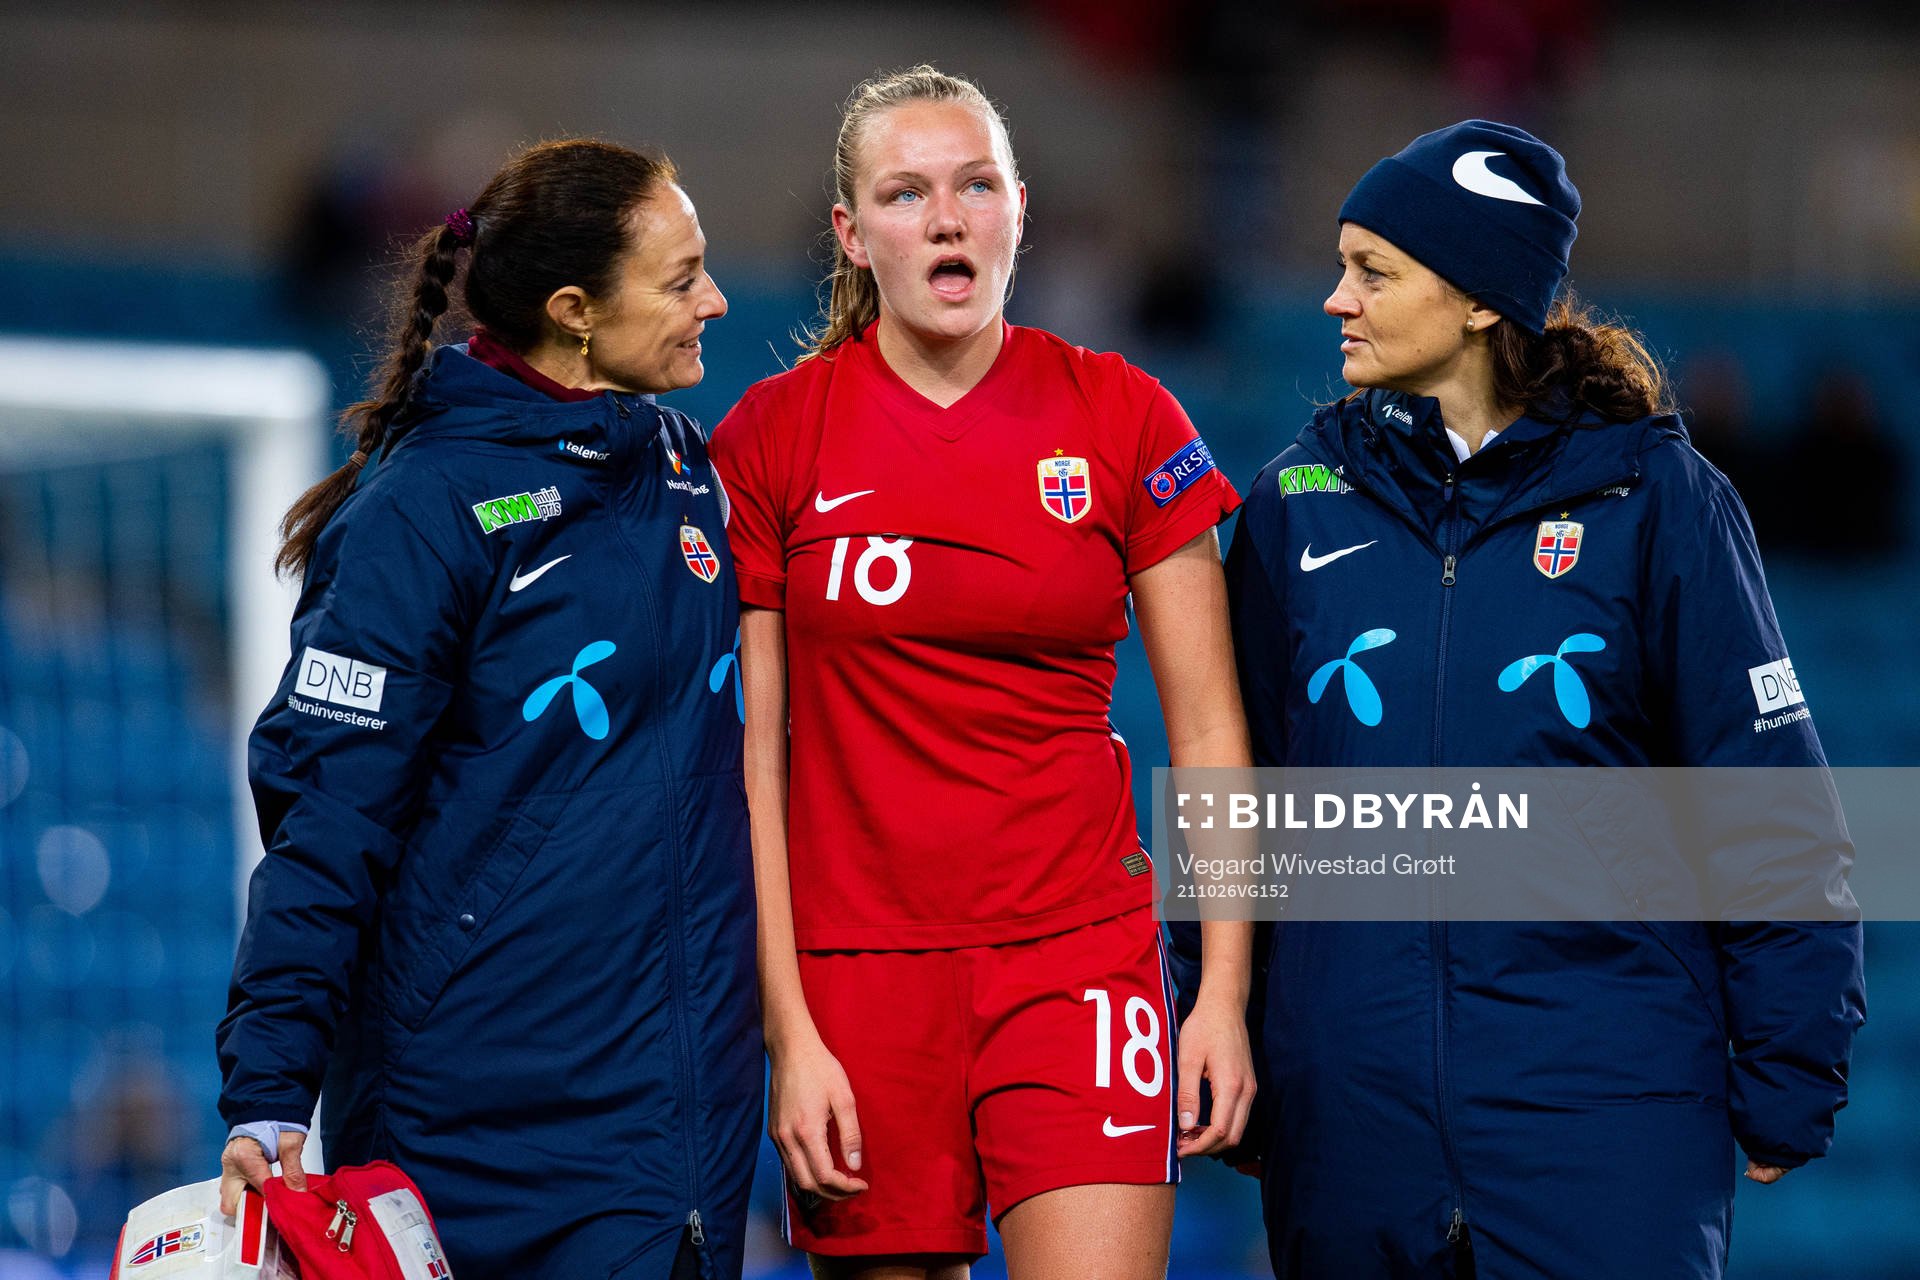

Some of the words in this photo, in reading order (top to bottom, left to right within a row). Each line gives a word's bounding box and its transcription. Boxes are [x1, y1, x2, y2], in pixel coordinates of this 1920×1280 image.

[1392, 408, 1413, 425] telen
[566, 441, 610, 460] telenor
[533, 486, 561, 504] mini
[1279, 464, 1340, 498] KIWI
[472, 492, 541, 534] KIWI
[540, 502, 561, 521] pris
[825, 533, 914, 606] 18
[306, 659, 373, 701] DNB
[287, 694, 388, 731] #huninvesterer
[1083, 988, 1164, 1097] 18
